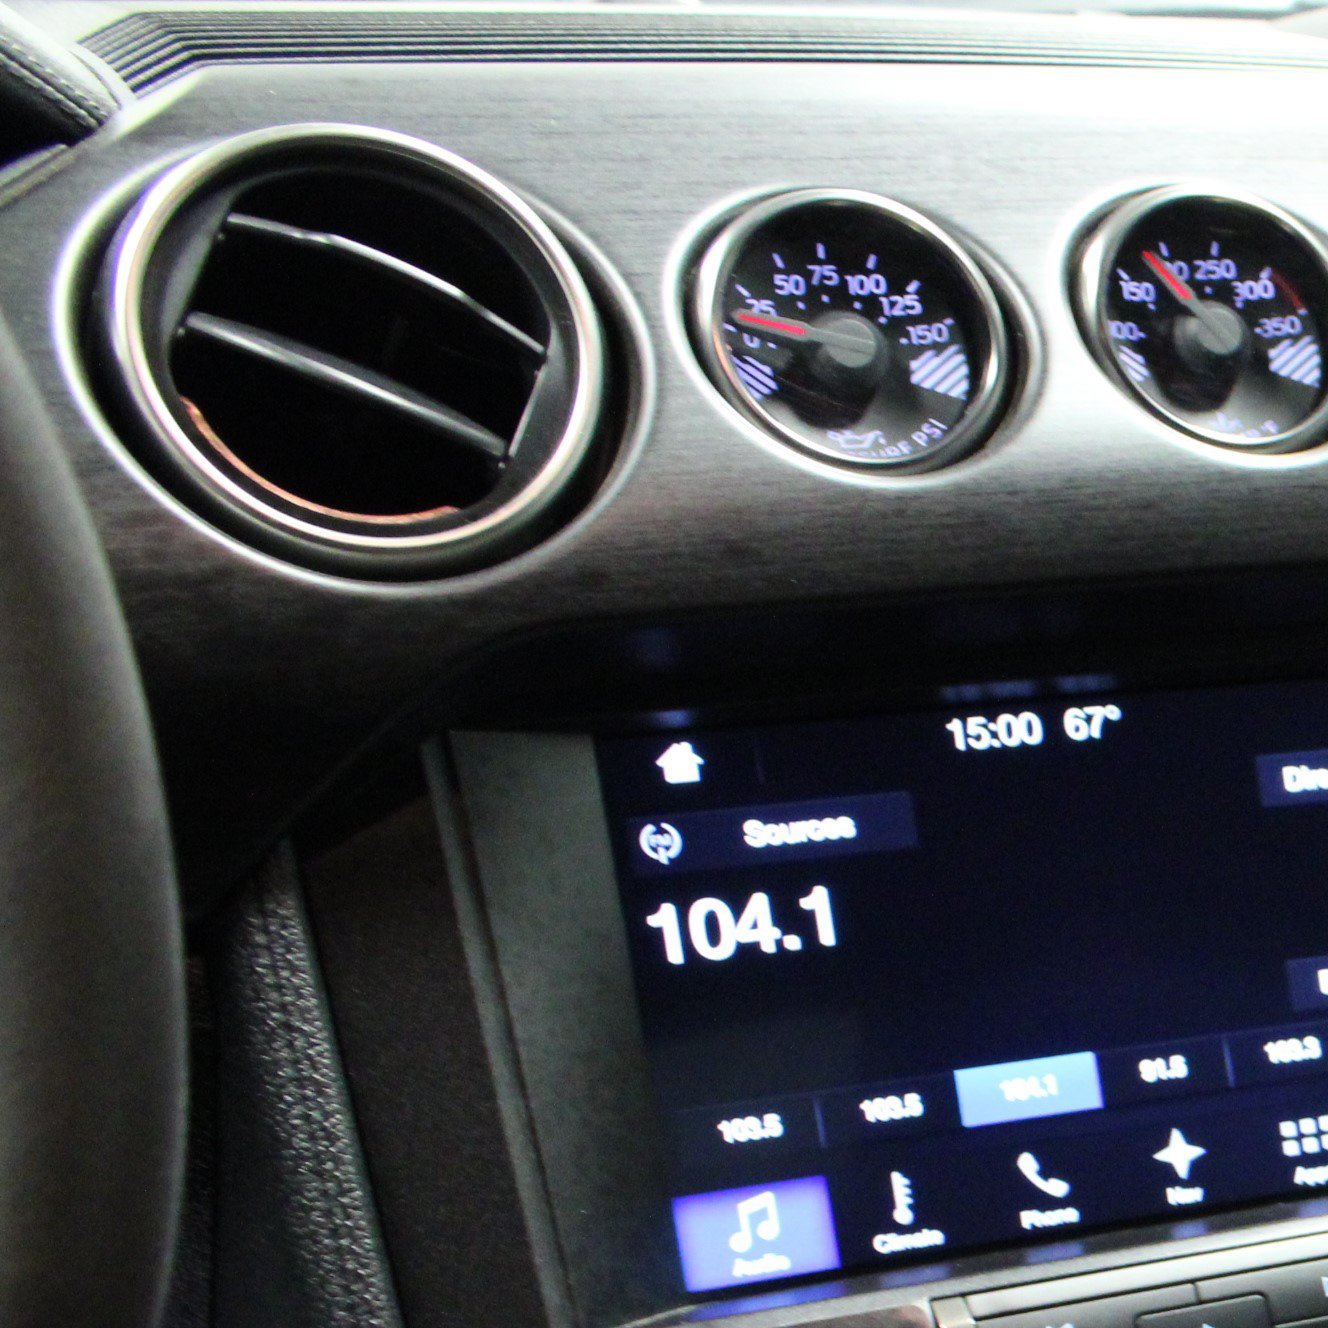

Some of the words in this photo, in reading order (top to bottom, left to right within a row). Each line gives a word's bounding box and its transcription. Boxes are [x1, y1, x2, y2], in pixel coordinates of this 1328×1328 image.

[807, 264, 840, 286] 75
[1193, 259, 1237, 281] 250
[773, 274, 807, 296] 50
[844, 274, 888, 296] 100
[1231, 279, 1275, 301] 300
[879, 294, 924, 316] 125
[905, 322, 950, 345] 150
[1258, 315, 1302, 338] 350
[911, 418, 948, 447] PSI
[945, 711, 1043, 751] 15:00
[1063, 703, 1122, 742] 67°
[742, 815, 857, 848] Sources
[646, 885, 837, 965] 104.1
